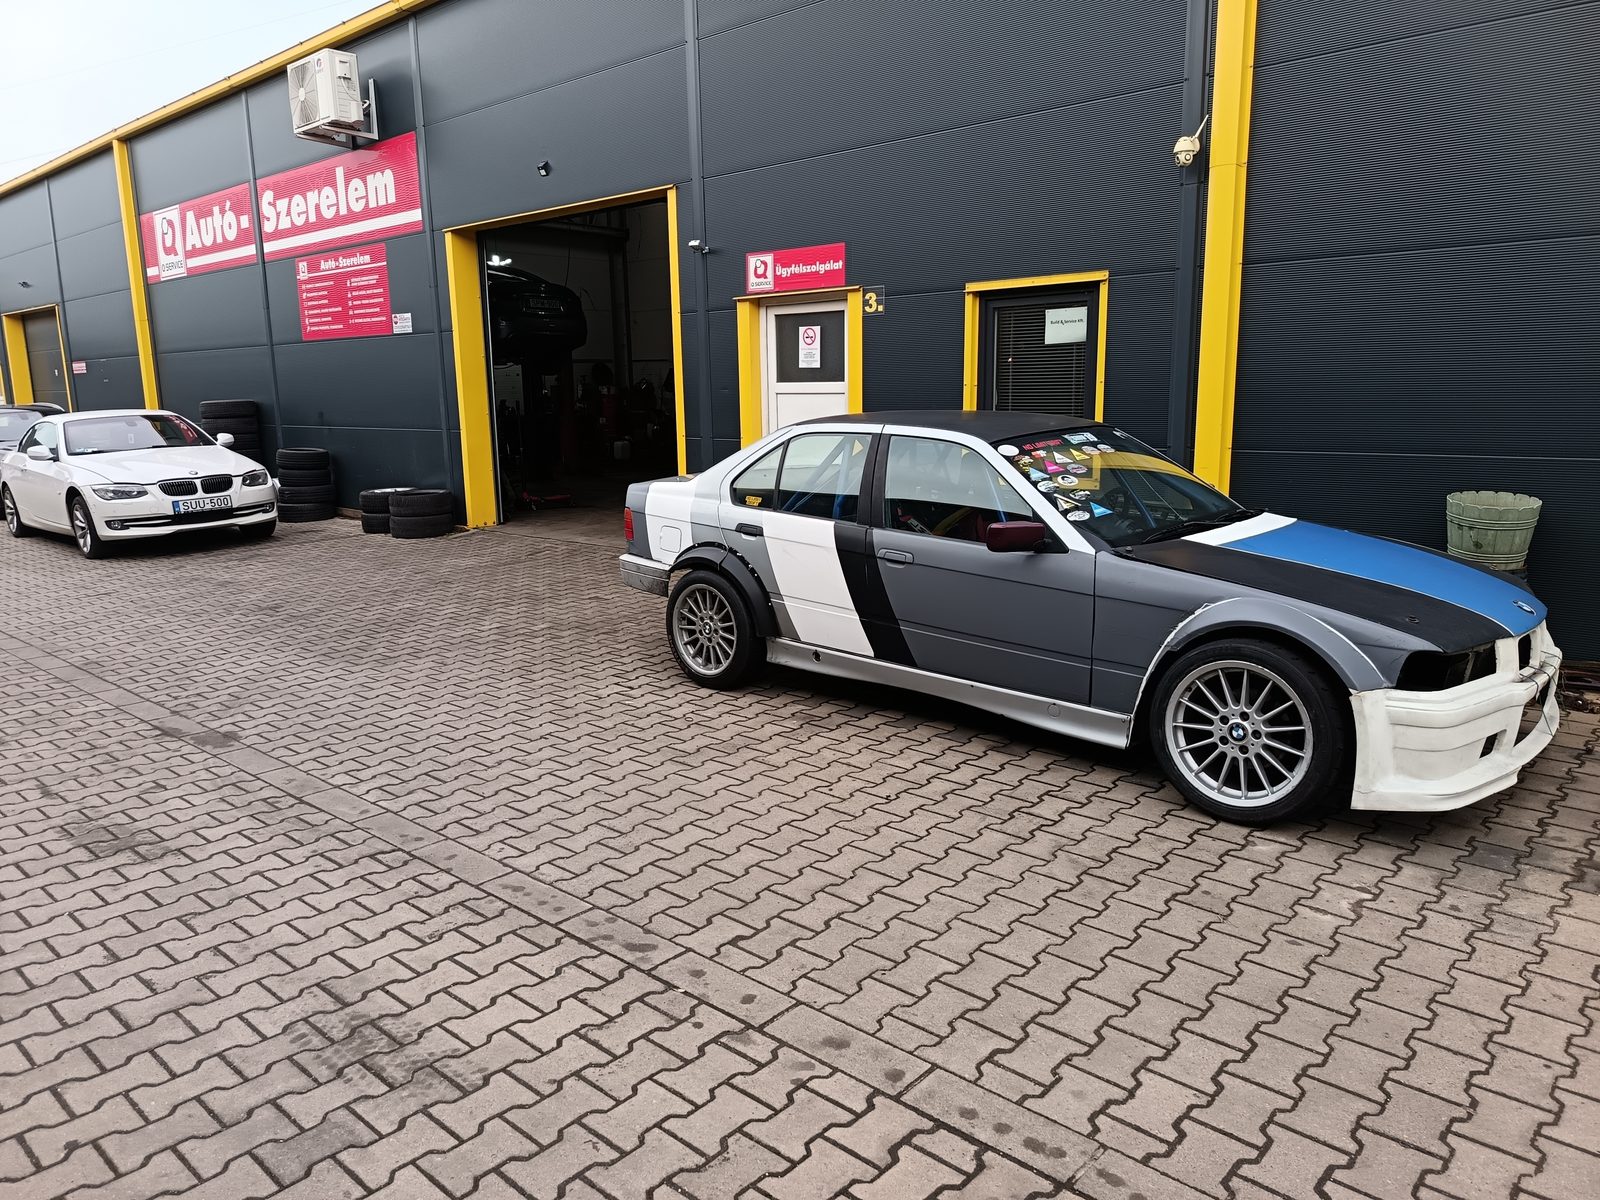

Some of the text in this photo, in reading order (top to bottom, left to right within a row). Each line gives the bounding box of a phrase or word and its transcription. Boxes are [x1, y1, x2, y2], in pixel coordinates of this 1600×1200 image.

[185, 166, 396, 251] Autó- Szerelem
[165, 259, 184, 271] SERVICE
[775, 260, 843, 277] Ügyfélszolgálat
[864, 292, 883, 313] 3.
[182, 497, 229, 511] SUU-500
